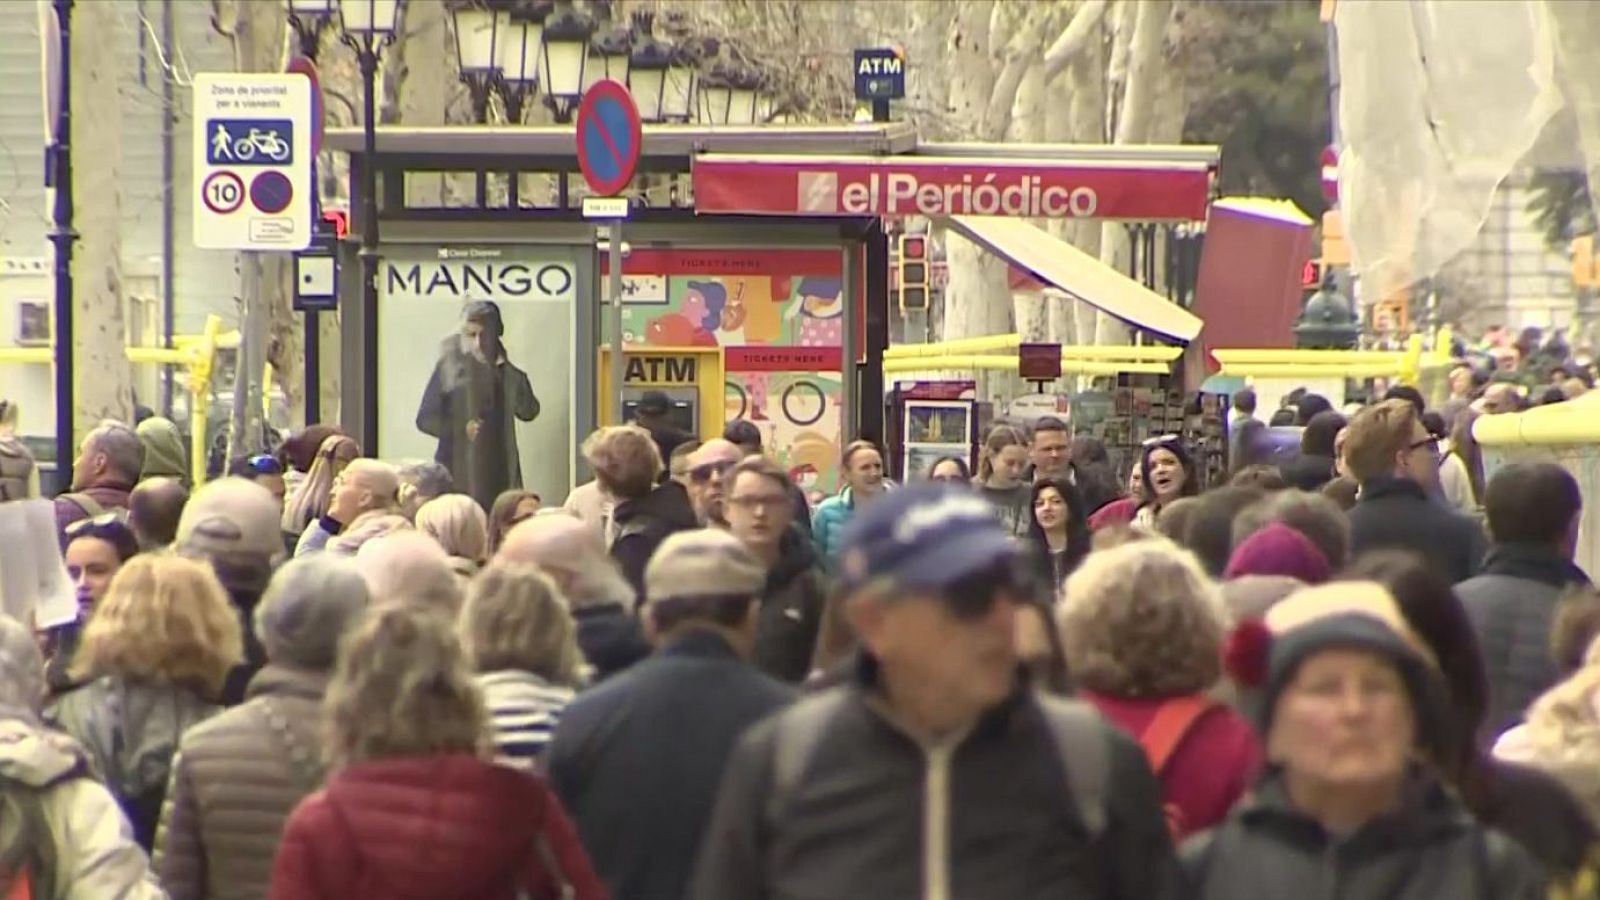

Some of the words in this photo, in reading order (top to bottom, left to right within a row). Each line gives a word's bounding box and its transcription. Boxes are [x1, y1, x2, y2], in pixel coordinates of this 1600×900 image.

[859, 58, 901, 74] ATM
[211, 184, 237, 202] 10
[842, 174, 879, 213] el
[887, 173, 1098, 217] Periódico
[387, 264, 572, 296] MANGO
[624, 357, 695, 382] ATM
